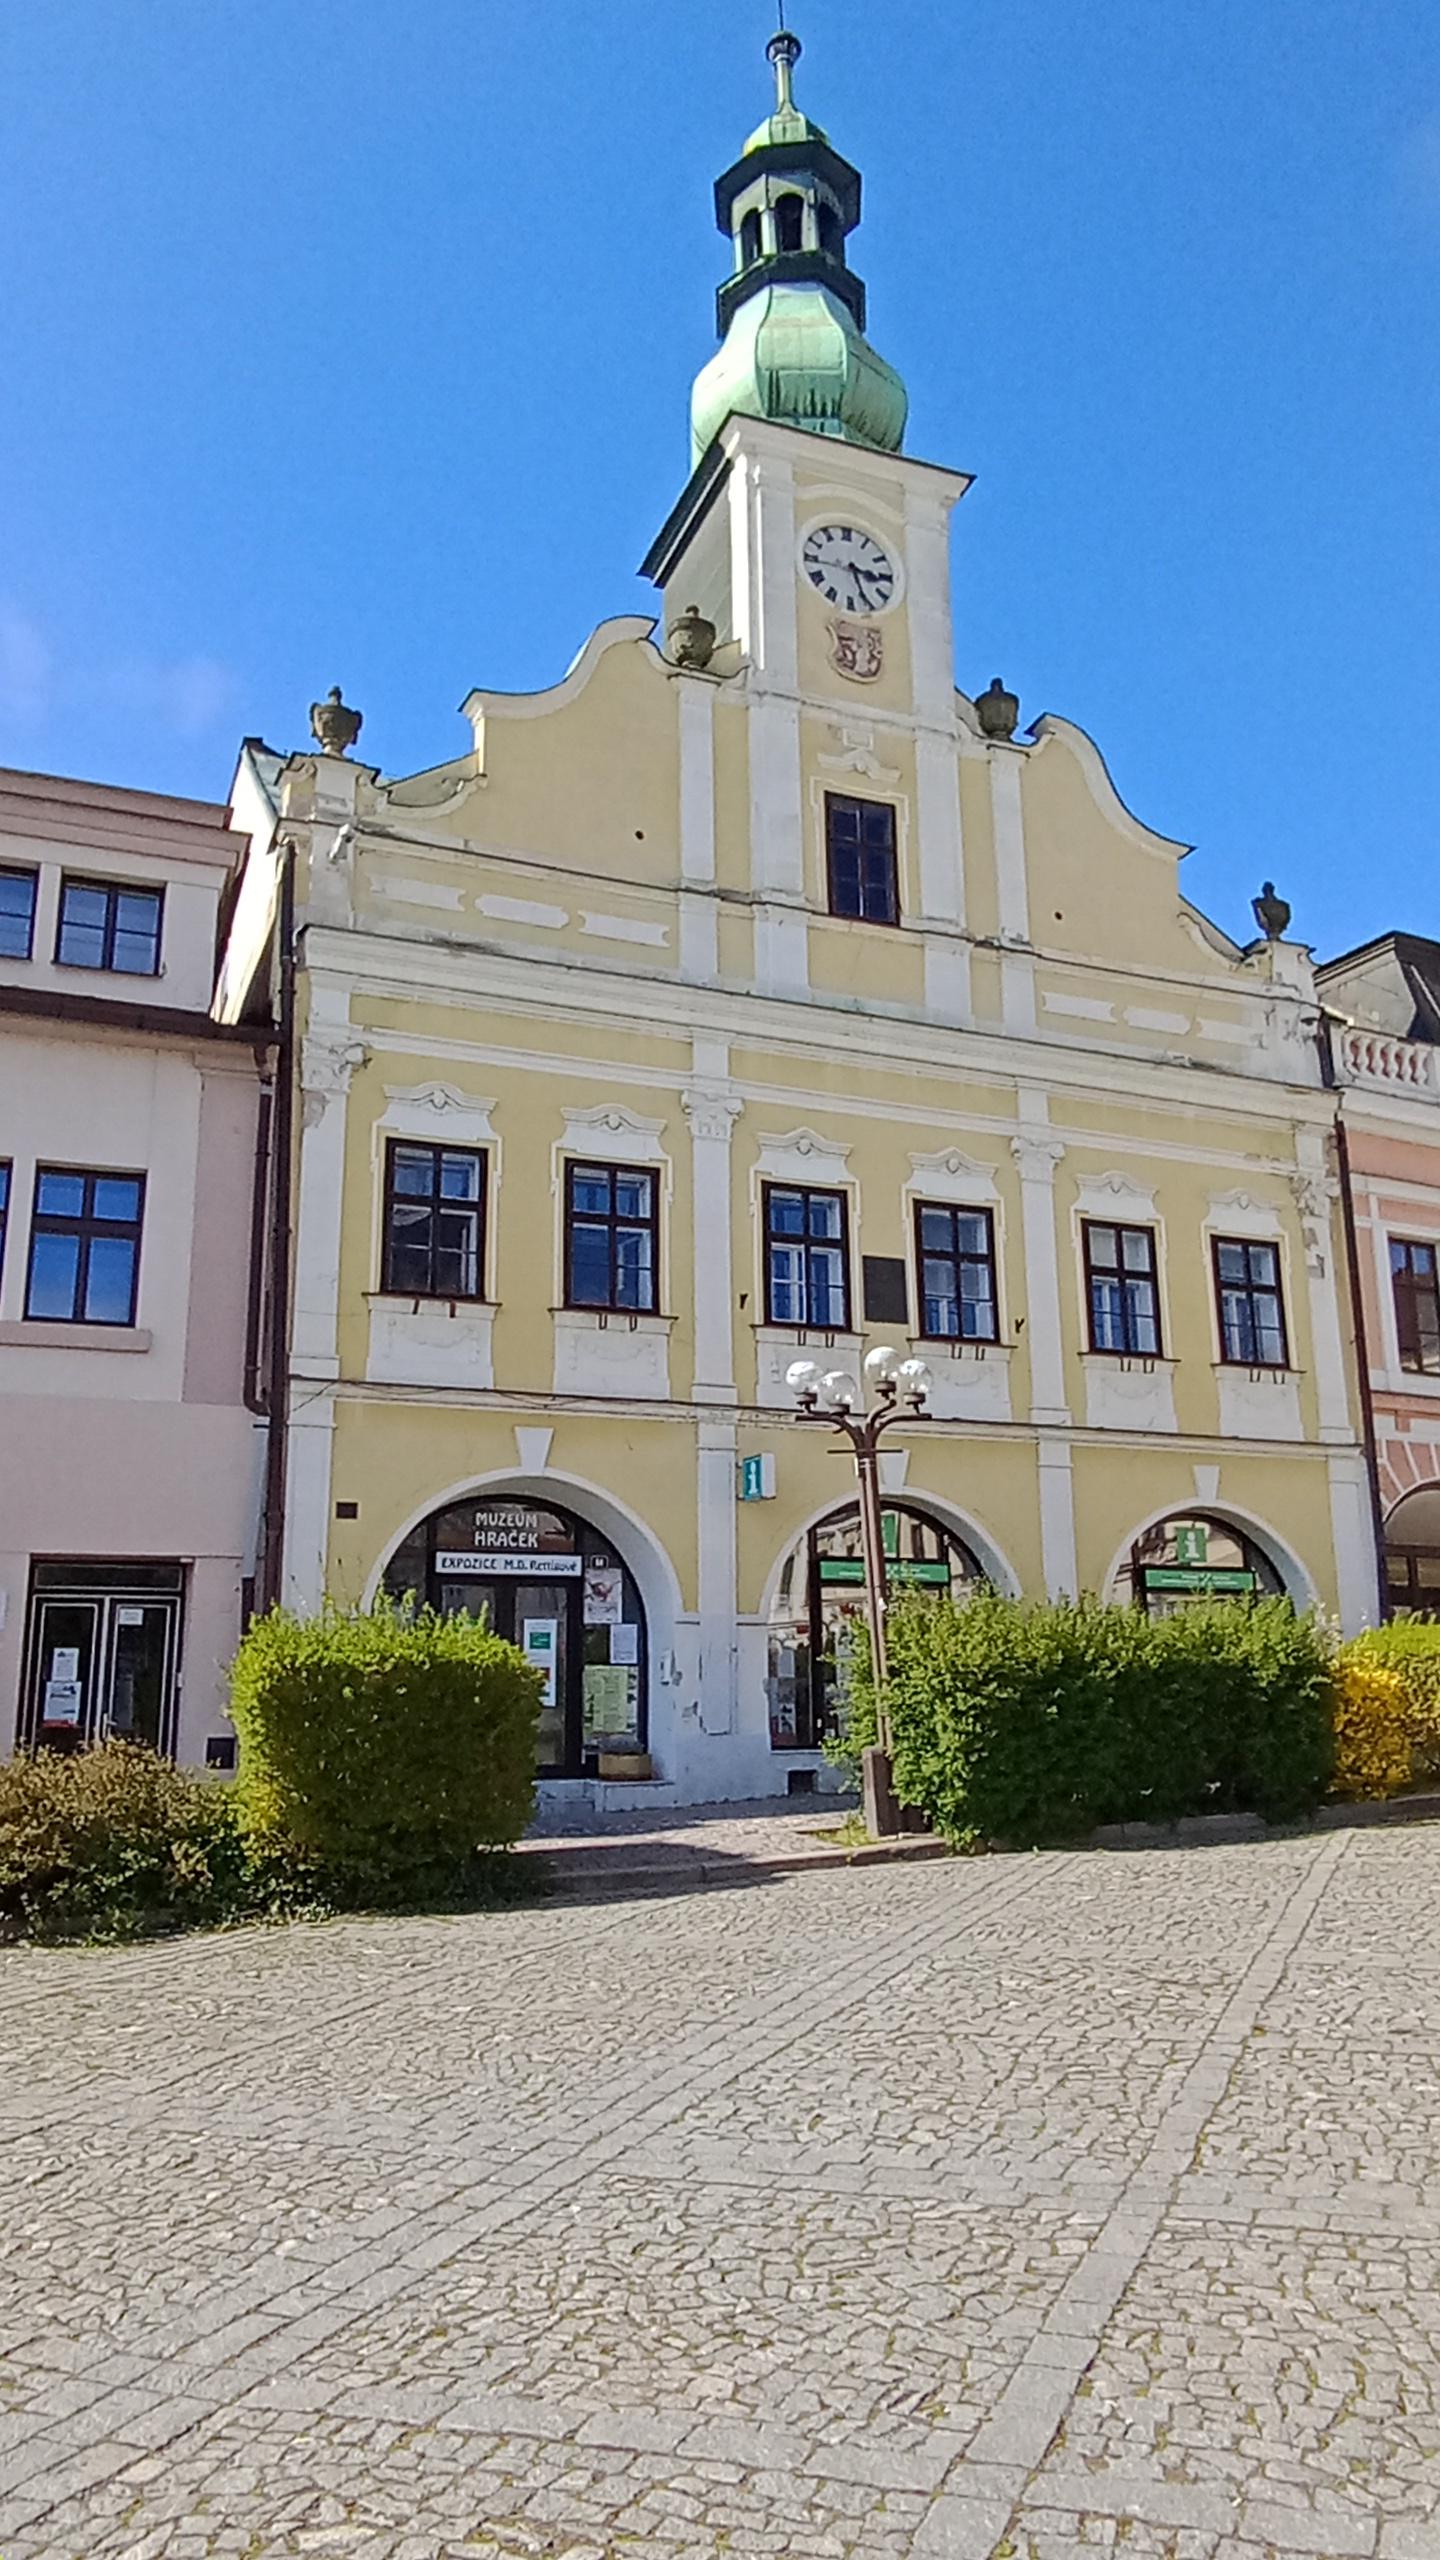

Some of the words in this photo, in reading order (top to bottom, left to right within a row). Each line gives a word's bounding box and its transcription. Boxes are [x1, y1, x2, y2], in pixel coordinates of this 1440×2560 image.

[475, 1512, 538, 1528] MUZEUM
[474, 1529, 538, 1548] HRAČEK
[441, 1557, 497, 1570] EXPOZICE
